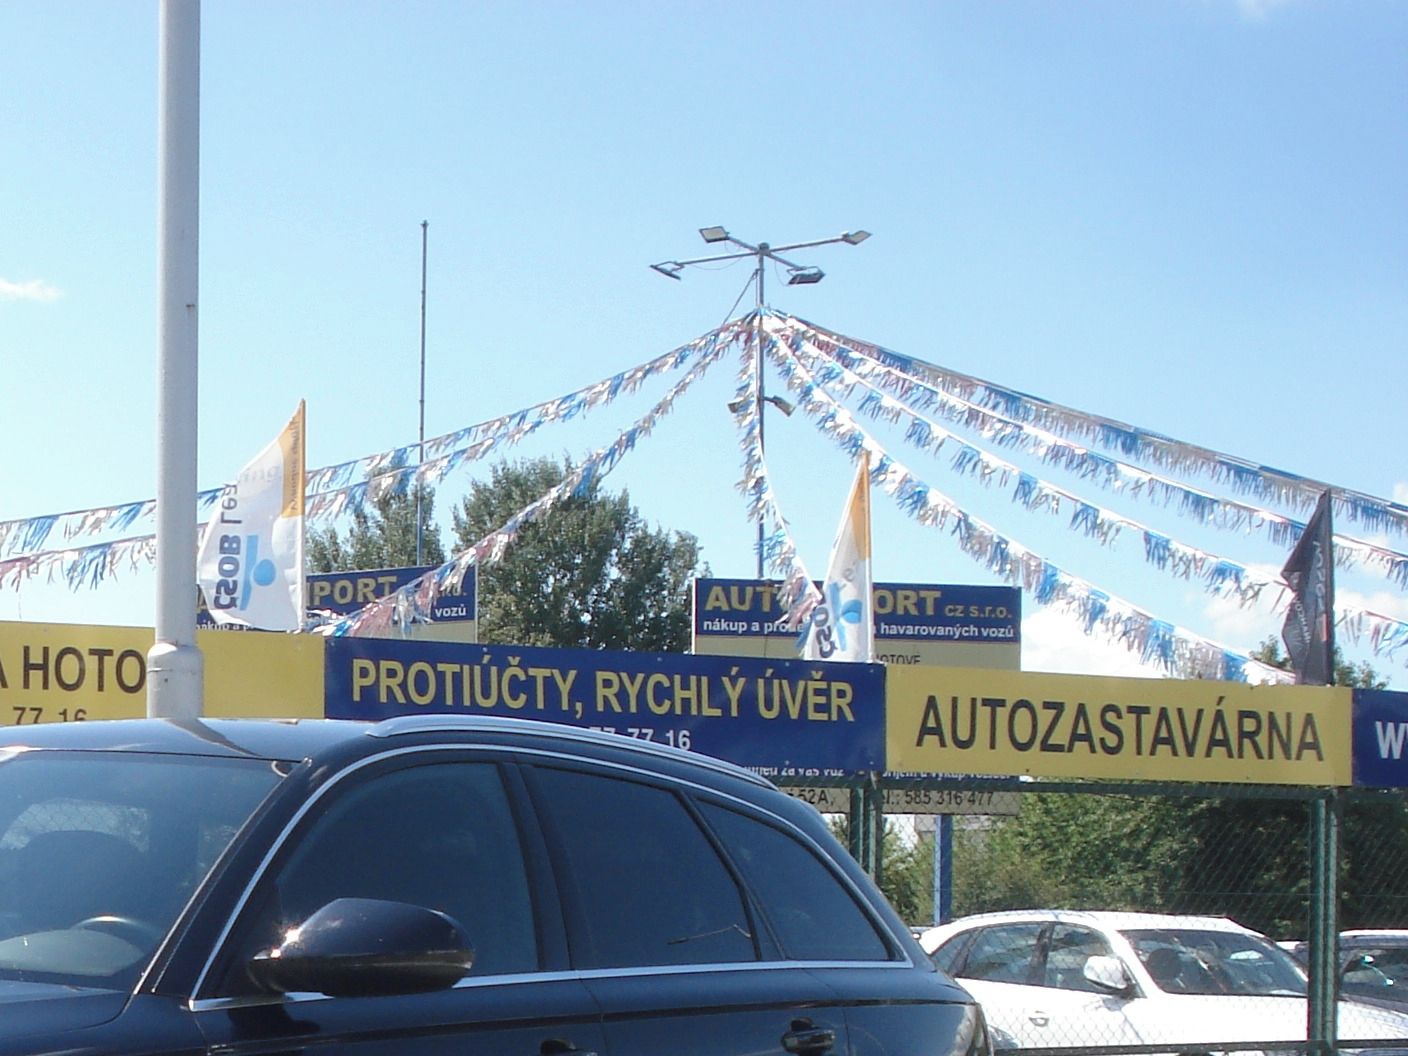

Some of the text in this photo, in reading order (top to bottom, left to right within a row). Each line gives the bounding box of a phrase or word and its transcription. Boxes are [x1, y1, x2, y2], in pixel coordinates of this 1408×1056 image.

[434, 603, 467, 618] vozů
[945, 604, 966, 617] cz
[969, 605, 1013, 619] s.r.o.
[703, 618, 748, 635] nákup
[750, 621, 761, 632] a
[880, 621, 979, 640] havarovaných
[22, 645, 147, 695] HOTO
[352, 654, 856, 723] PROTIÚČTY, RYCHLÝ ÚVĚR
[12, 706, 44, 725] 77
[915, 694, 1325, 763] AUTOZASTAVÁRNA
[1375, 720, 1408, 759] W
[665, 729, 691, 751] 16
[904, 789, 932, 805] 585
[936, 790, 964, 806] 316
[967, 791, 995, 806] 477
